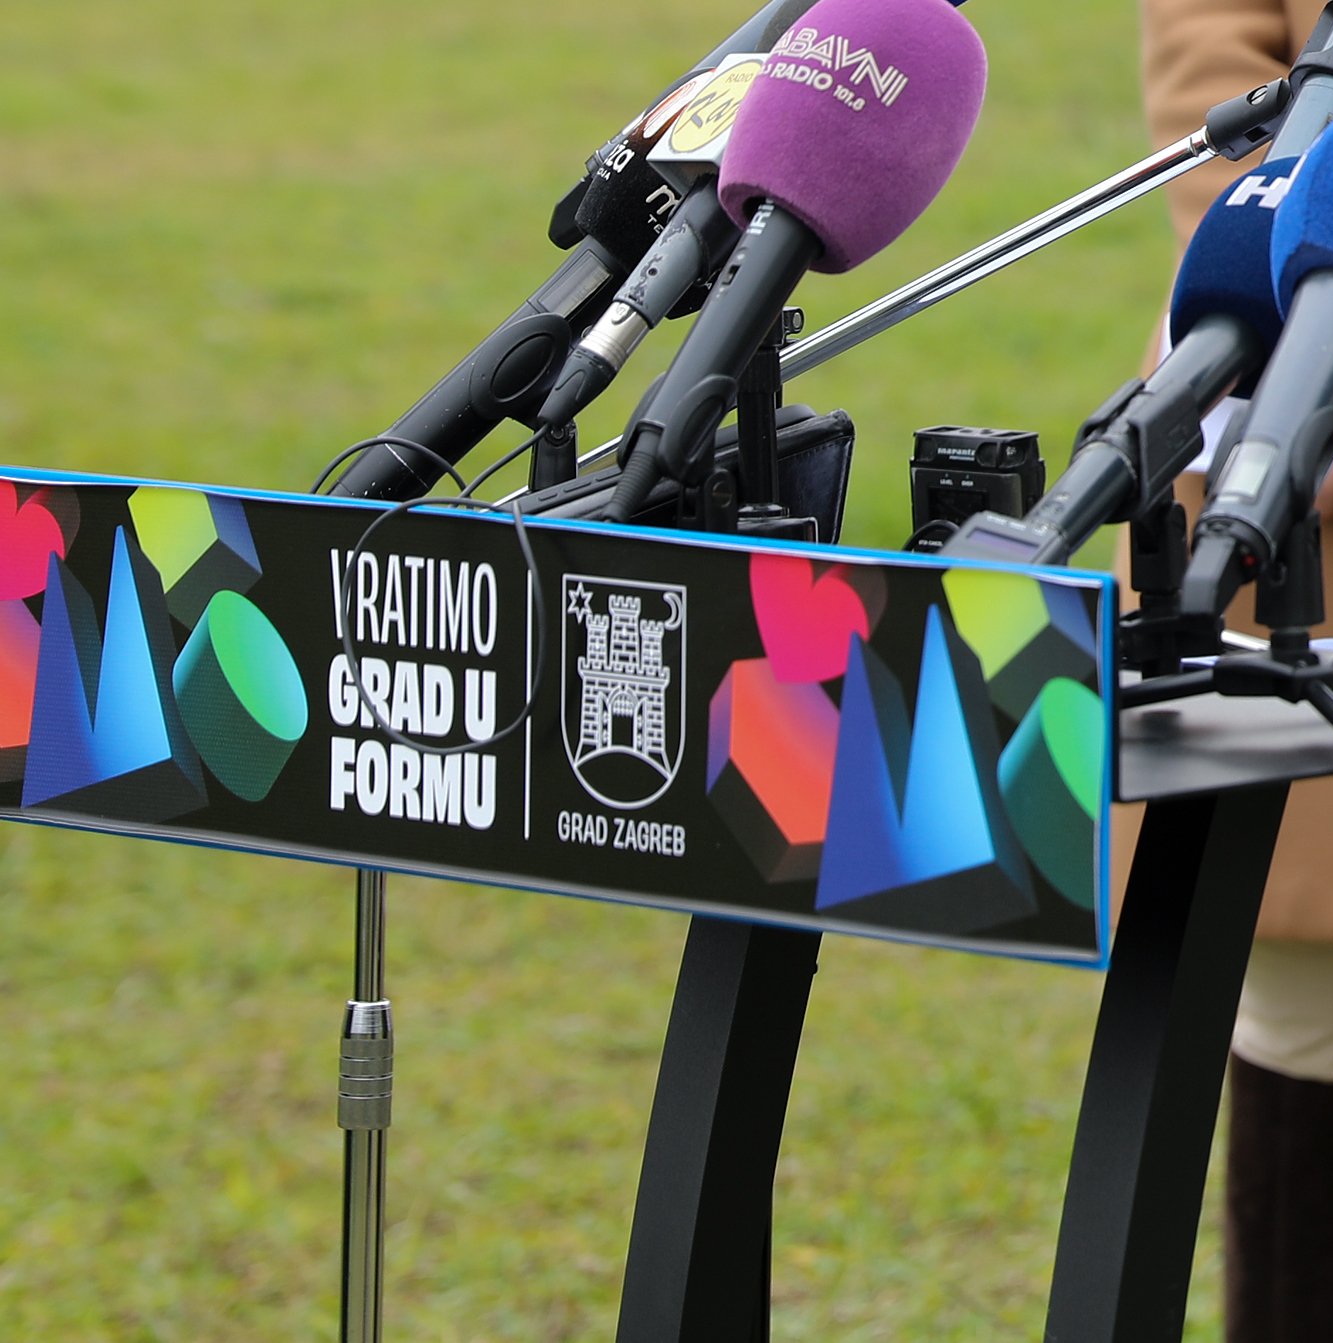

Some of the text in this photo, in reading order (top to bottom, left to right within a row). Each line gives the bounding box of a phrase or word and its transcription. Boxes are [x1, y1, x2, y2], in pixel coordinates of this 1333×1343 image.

[725, 73, 755, 85] RADIO
[770, 27, 909, 107] ABAVNI
[770, 62, 834, 92] RADIO
[330, 548, 499, 657] VRATIMO
[328, 653, 497, 744] GRAD U
[330, 736, 498, 831] FORMU
[557, 810, 686, 857] GRAD ZAGREB
